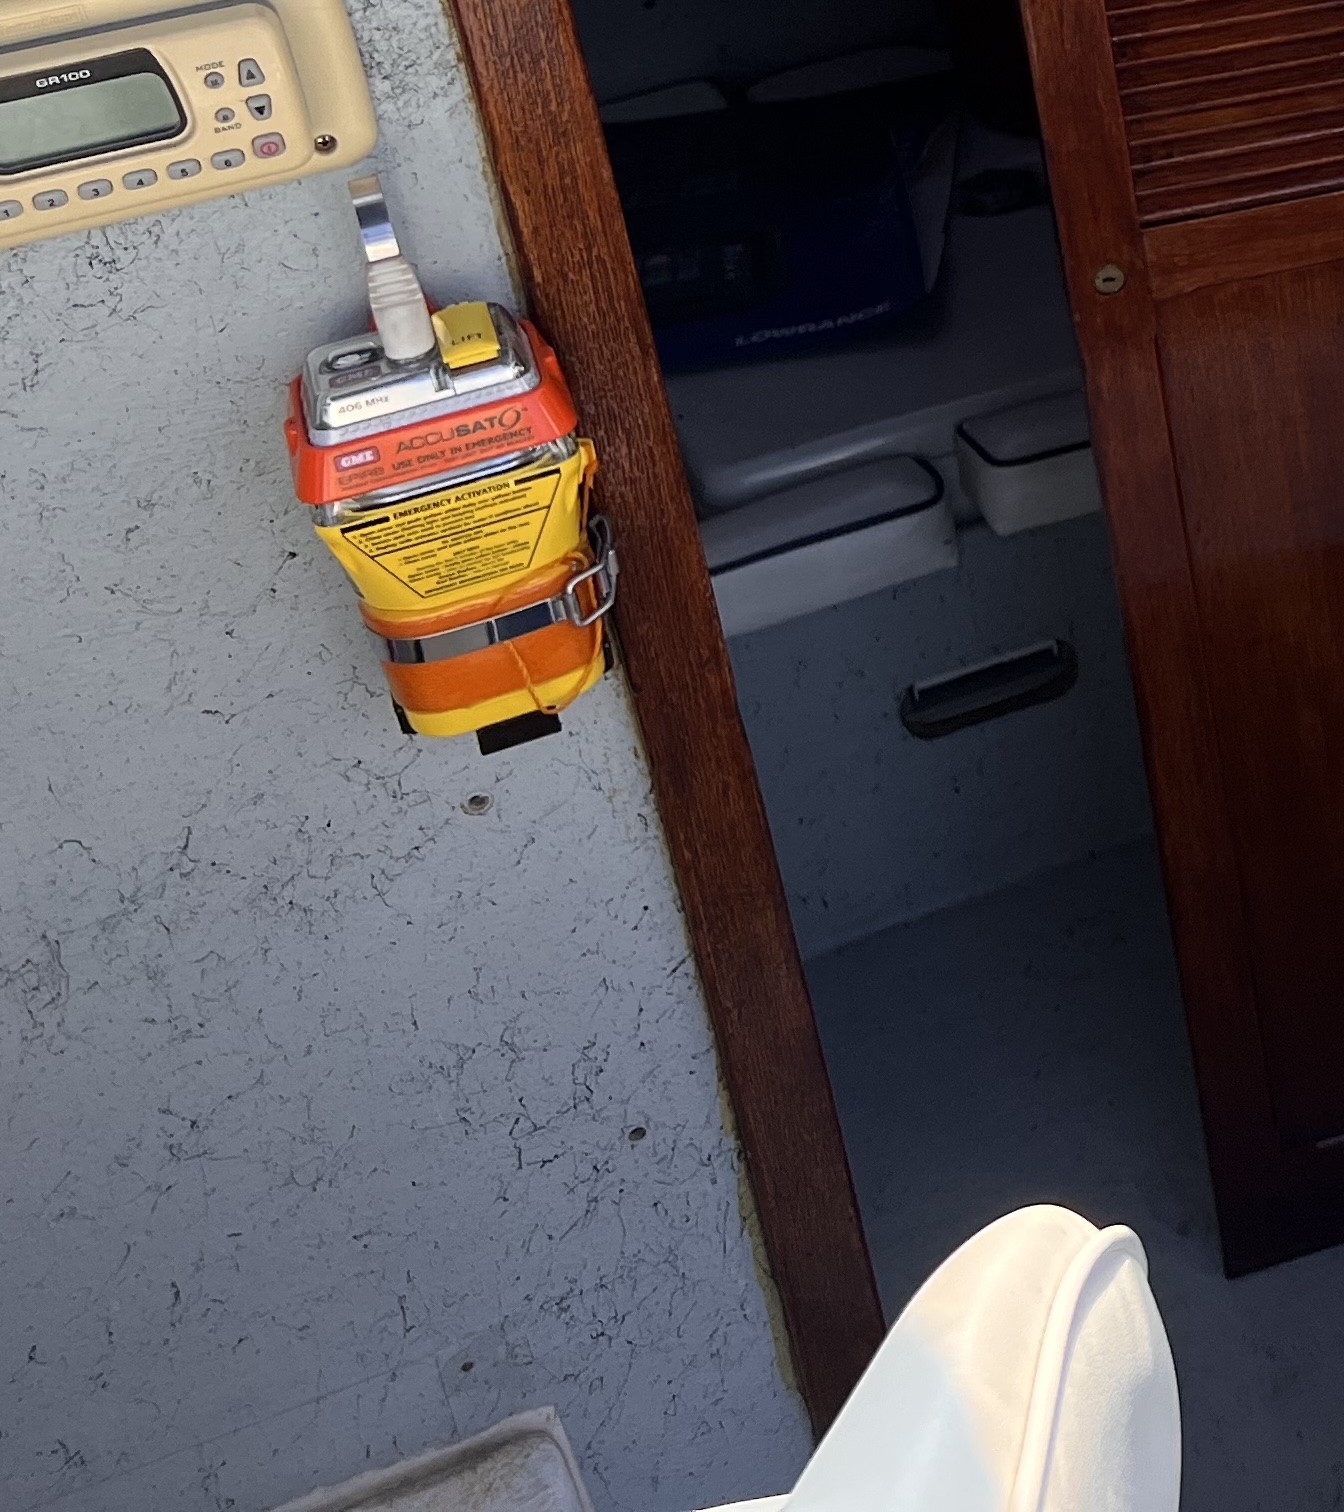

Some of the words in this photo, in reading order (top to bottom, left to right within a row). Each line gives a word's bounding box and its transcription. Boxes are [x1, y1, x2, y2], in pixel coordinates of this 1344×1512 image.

[195, 60, 226, 73] MODE
[35, 69, 91, 88] GR100
[214, 123, 242, 134] BAND
[47, 198, 55, 207] 2
[92, 188, 100, 197] 3
[136, 178, 145, 186] 4
[180, 168, 189, 177] 5
[224, 159, 232, 168] 6
[735, 300, 891, 347] LOWRANCE
[451, 332, 483, 345] LIFT
[338, 402, 363, 414] 406
[365, 396, 390, 408] MHz
[392, 460, 414, 472] USE
[417, 450, 448, 467] ONLY
[450, 445, 463, 455] IN
[465, 427, 533, 451] EMERGENCY
[340, 450, 375, 468] GME
[393, 498, 451, 520] EMERGENCY
[454, 482, 510, 503] ACTIVATION
